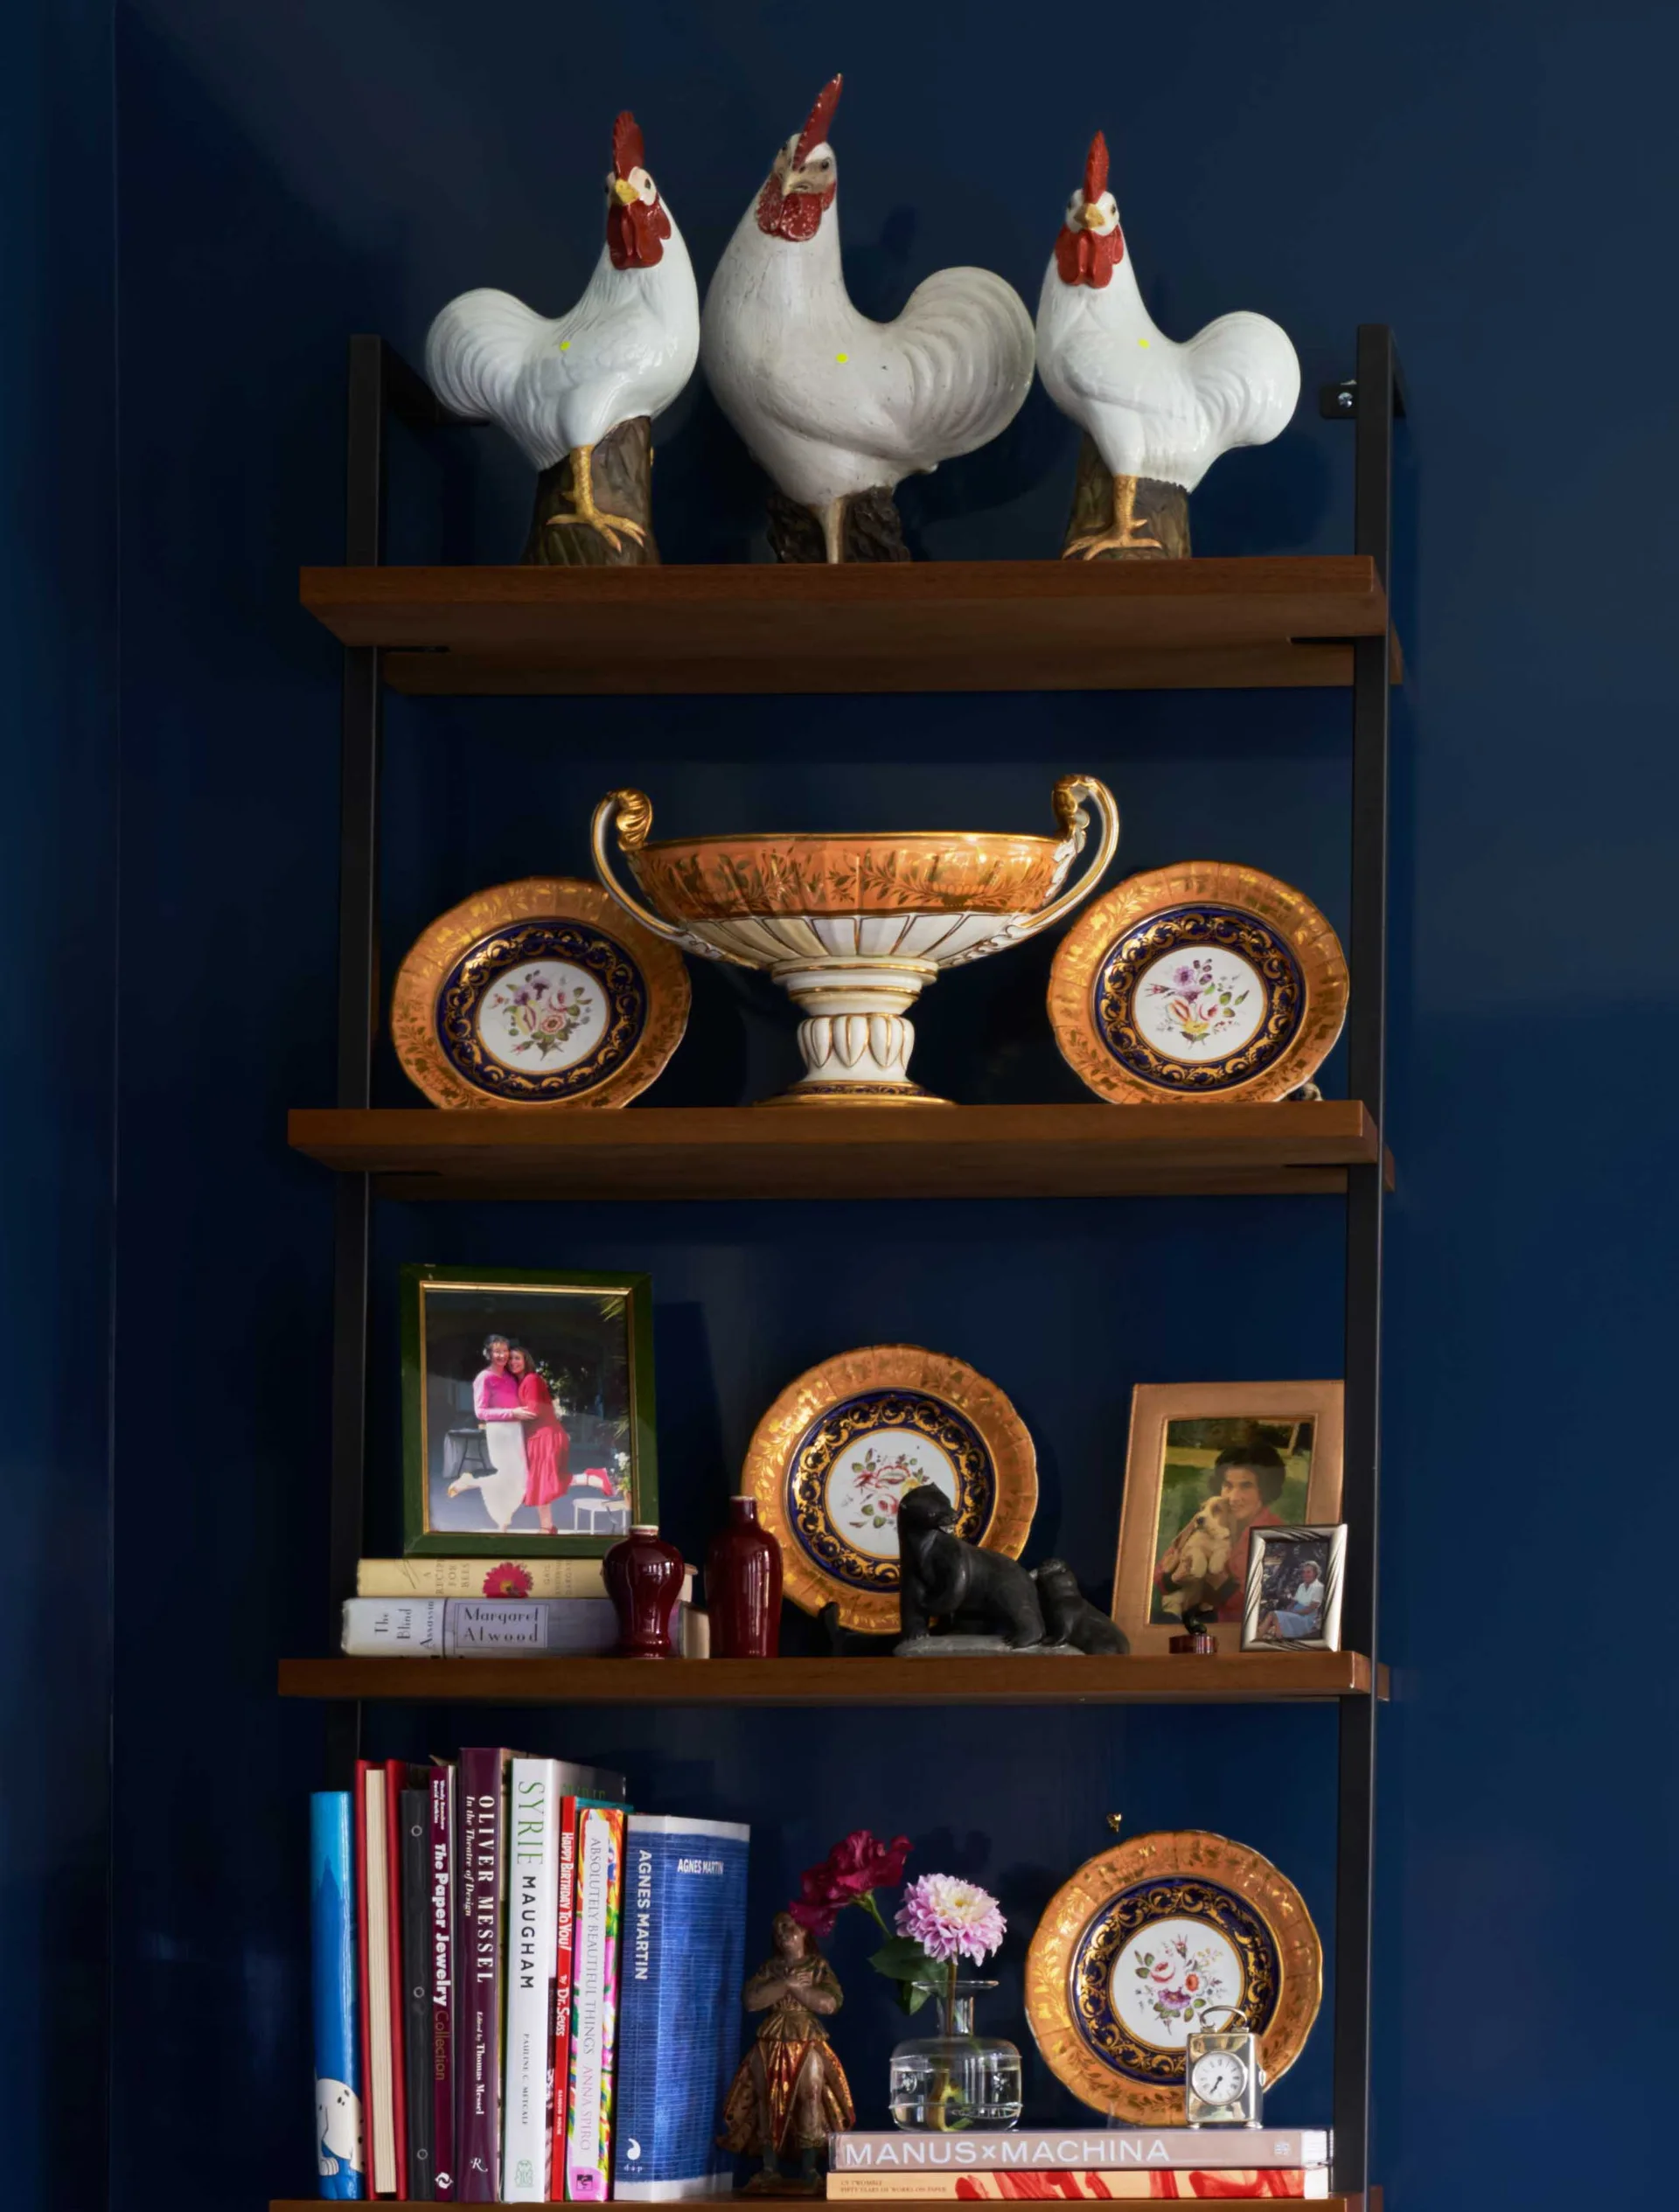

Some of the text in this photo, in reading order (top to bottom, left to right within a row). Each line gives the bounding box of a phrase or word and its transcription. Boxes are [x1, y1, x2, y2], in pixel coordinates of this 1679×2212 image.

[448, 1565, 456, 1586] FOR
[374, 1612, 389, 1636] The
[396, 1608, 412, 1640] Blind
[419, 1601, 435, 1650] Assassin
[464, 1607, 539, 1624] Margaret
[463, 1624, 538, 1642] Atwood
[463, 1796, 475, 1916] In the Theatre of Design
[677, 1858, 724, 1875] AGNES MARTIN
[477, 1795, 495, 1983] OLIVER MESSEL
[517, 1781, 546, 1989] SYRIE MAUGHAM
[634, 1849, 652, 1980] AGNES MARTIN
[432, 1843, 450, 2080] The Paper Jewelry Collection
[557, 1988, 569, 2007] Dr.
[580, 1838, 602, 2151] ABSOLUTELY BEAUTIFUL THINGS ANNA SPIRO
[555, 2007, 570, 2036] Seuss
[476, 2042, 485, 2080] Thomas
[475, 2083, 484, 2115] Messel
